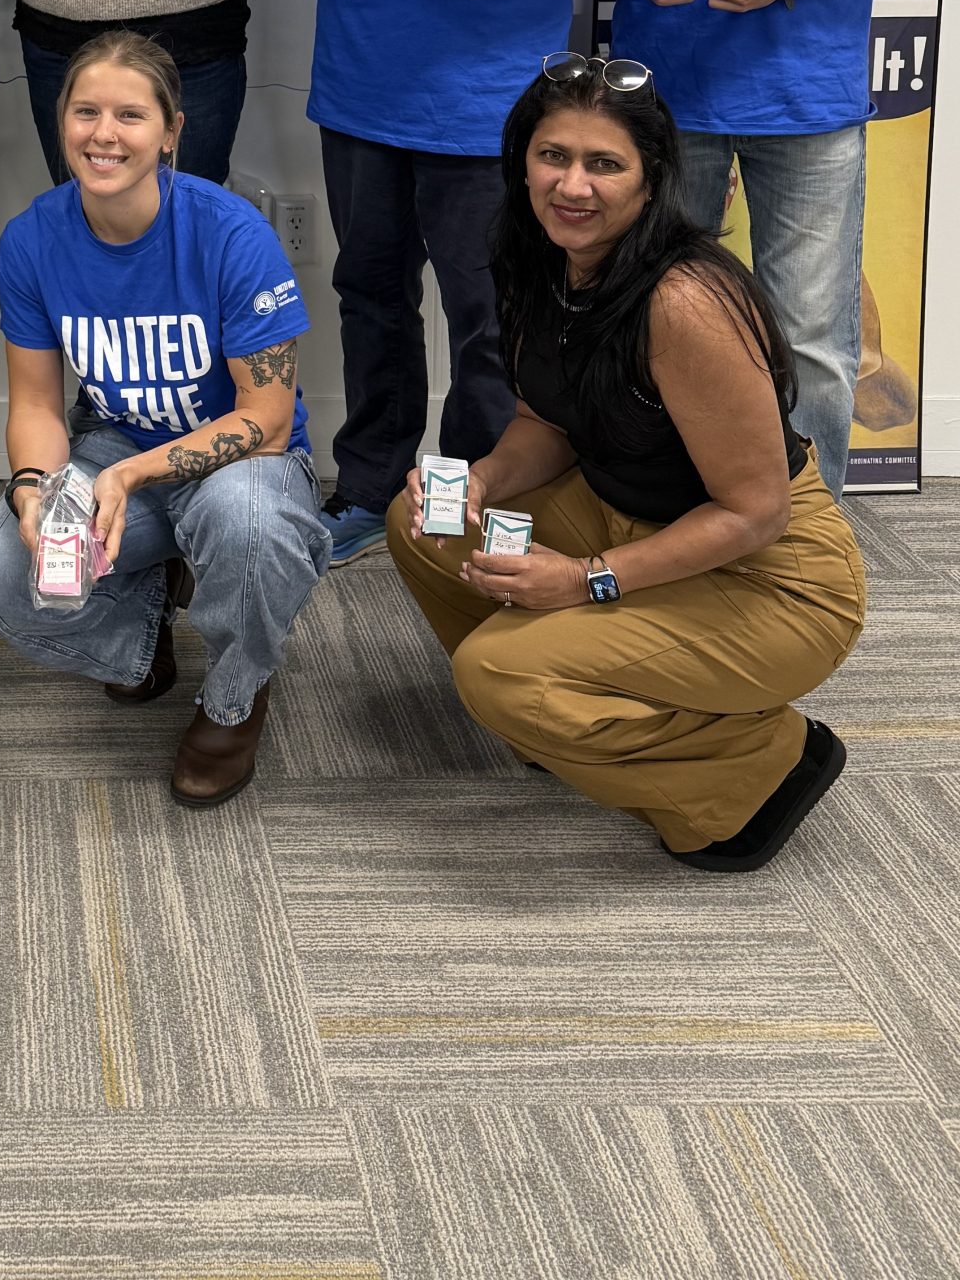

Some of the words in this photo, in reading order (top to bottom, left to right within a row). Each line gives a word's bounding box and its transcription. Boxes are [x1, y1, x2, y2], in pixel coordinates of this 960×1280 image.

[871, 35, 928, 92] It!
[60, 313, 213, 383] UNITED
[119, 382, 212, 433] THE
[884, 456, 917, 464] COMMITTEE
